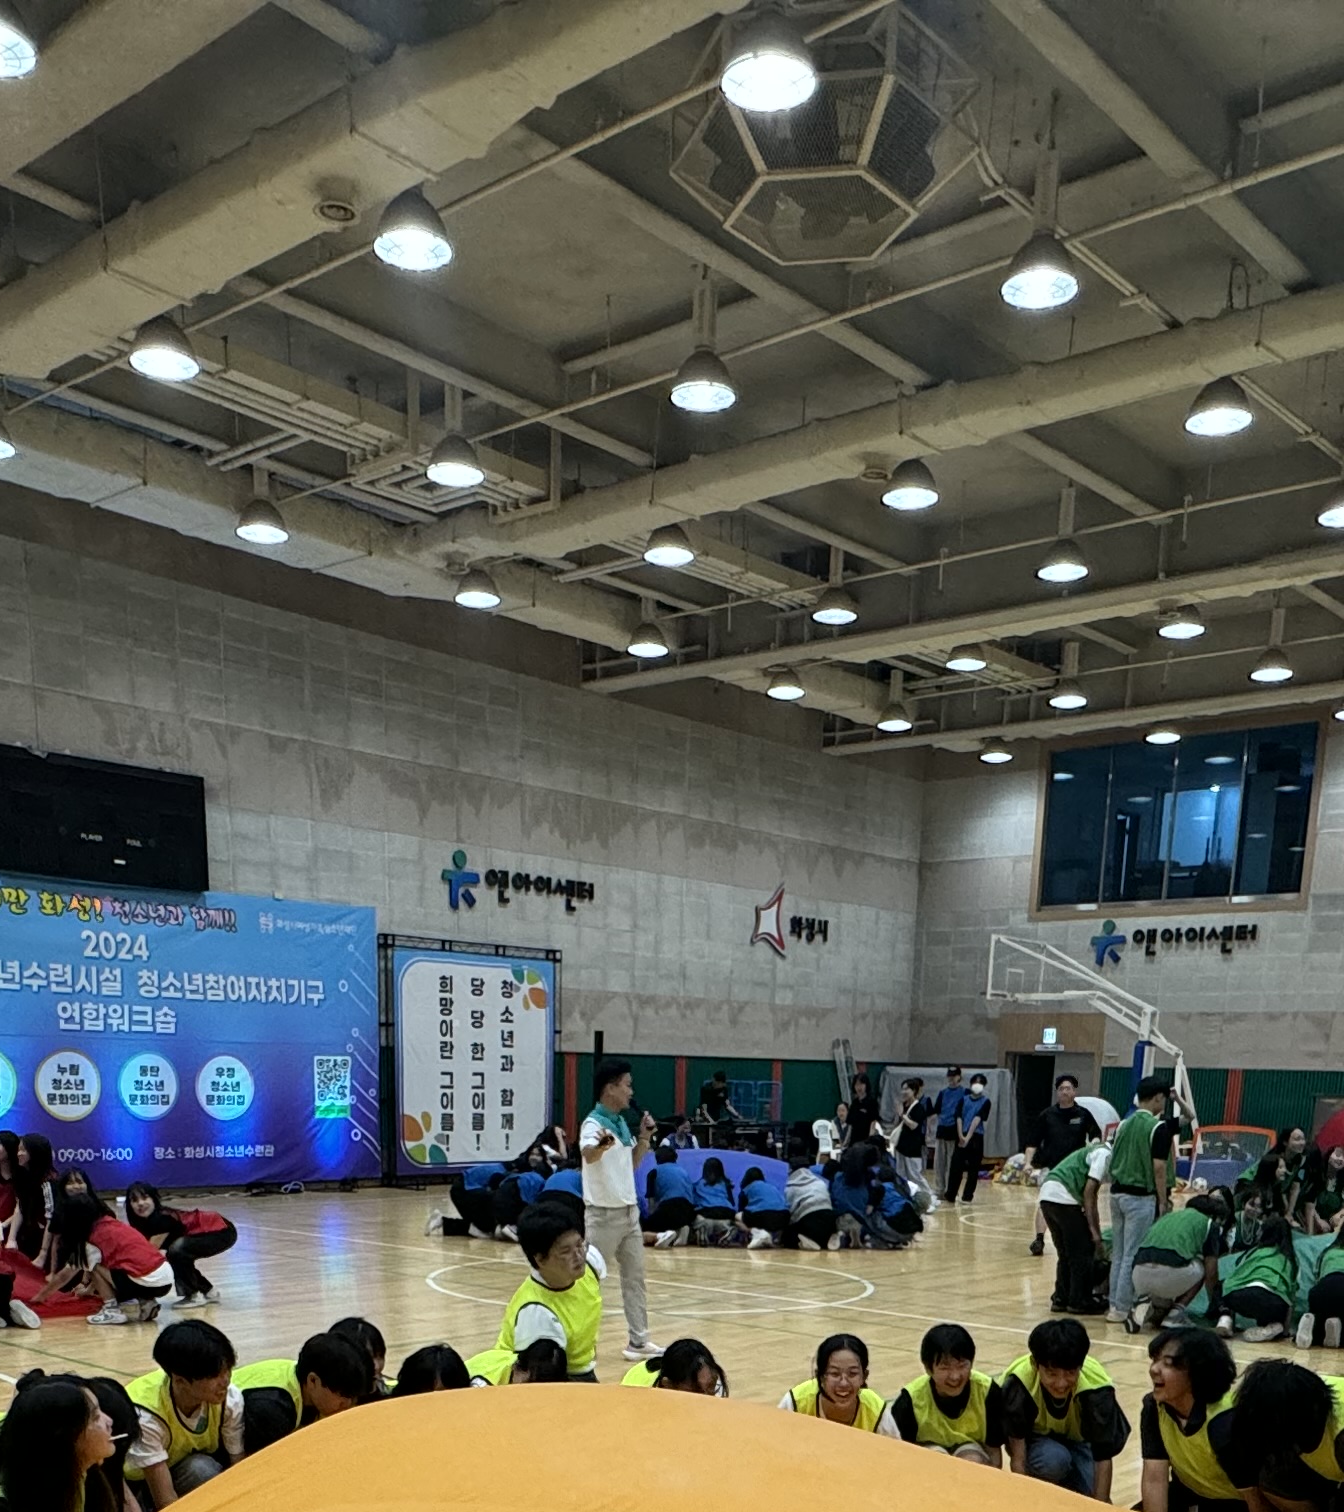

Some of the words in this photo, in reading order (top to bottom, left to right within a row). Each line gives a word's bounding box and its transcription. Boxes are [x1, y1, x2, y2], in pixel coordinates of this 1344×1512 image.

[37, 888, 105, 923] 화성!
[111, 898, 186, 928] 청소년과
[789, 915, 829, 944] 화성시
[80, 930, 151, 962] 2024
[137, 968, 326, 1008] 청소년참여자치기구
[57, 1000, 178, 1035] 연합워크숍
[139, 1065, 161, 1078] 동탄
[51, 1078, 85, 1091] 청소년
[133, 1079, 165, 1092] 청소년
[210, 1080, 242, 1093] 청소년
[46, 1092, 92, 1106] 문화의집
[128, 1093, 171, 1106] 문화의집
[205, 1094, 246, 1107] 문화의집
[58, 1147, 133, 1163] 09:00~16:00
[153, 1146, 176, 1160] 장소
[184, 1144, 275, 1159] 화성시청소년수련관
